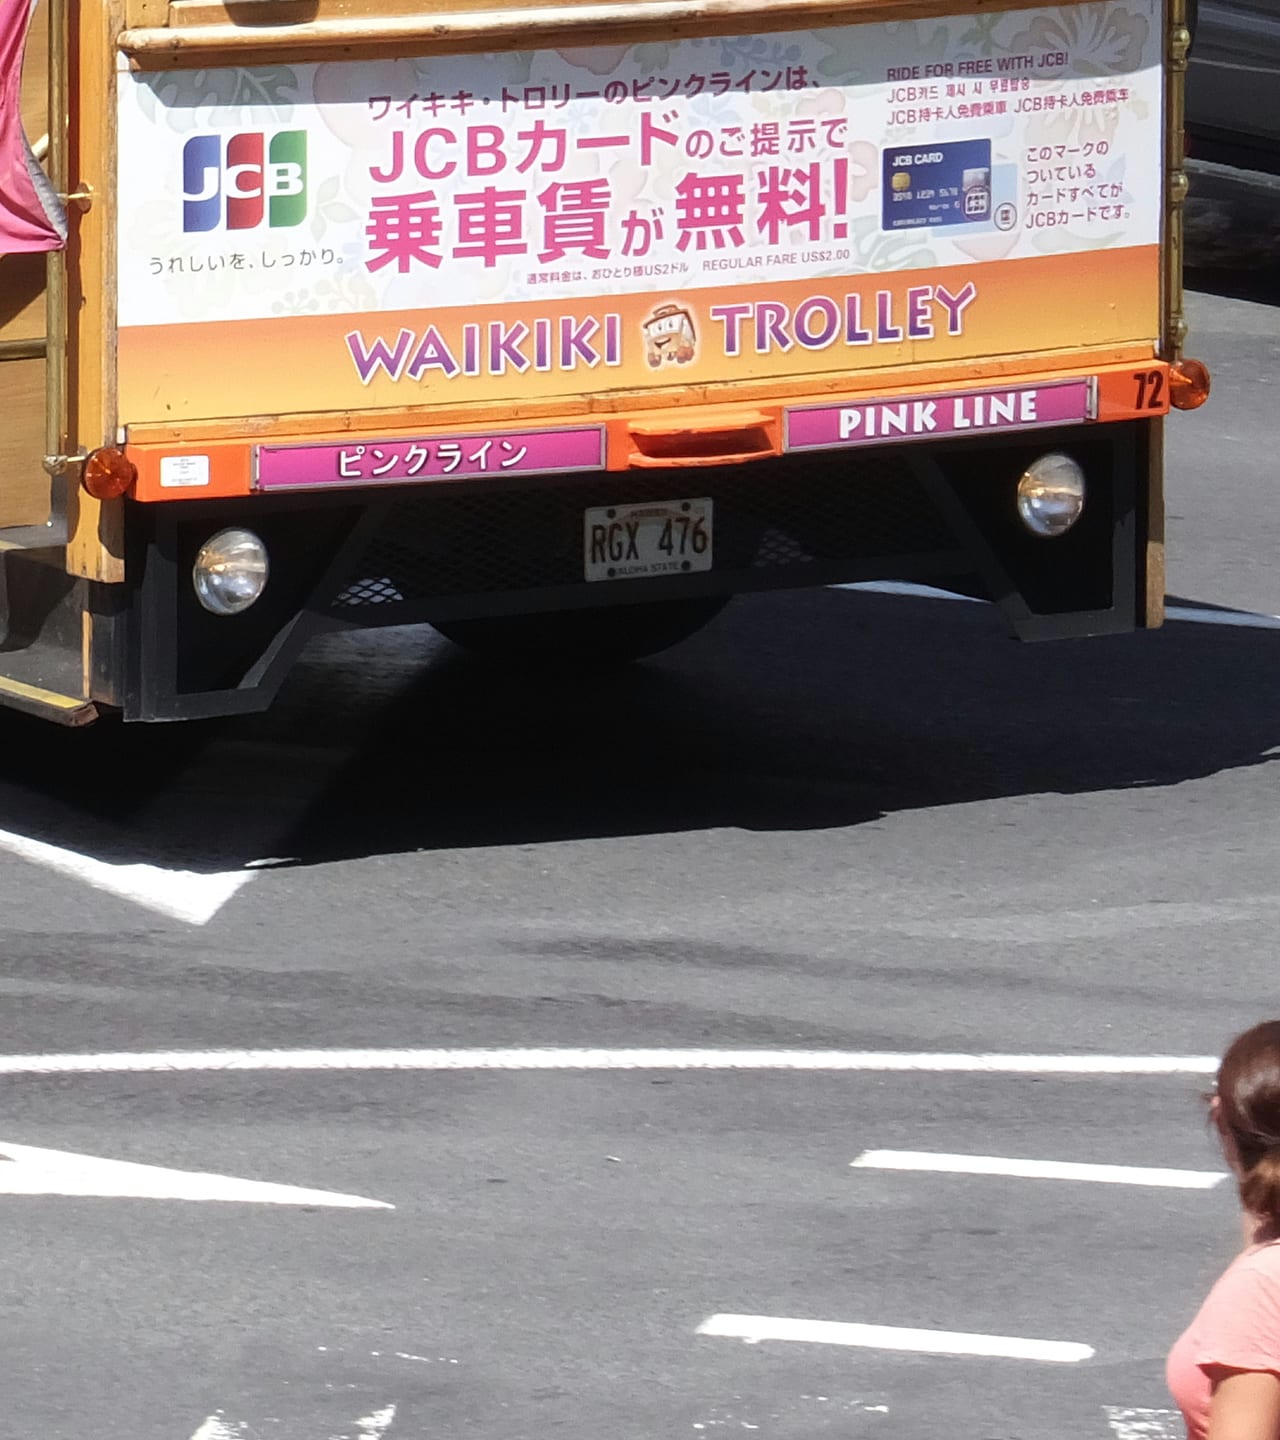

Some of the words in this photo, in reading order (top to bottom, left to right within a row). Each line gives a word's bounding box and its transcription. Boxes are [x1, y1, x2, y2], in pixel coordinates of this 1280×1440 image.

[886, 66, 920, 82] RIDE
[924, 62, 955, 79] FOR
[957, 59, 993, 76] FREE
[996, 55, 1034, 72] WITH
[1037, 52, 1069, 68] JCB!
[366, 65, 822, 121] ワイキキ・トロリーのピンクラインは、
[368, 110, 849, 183] JCBカードのご提示で
[892, 154, 912, 167] JCB
[914, 152, 944, 165] CARD
[1026, 140, 1109, 163] このマークの
[1026, 163, 1096, 183] ついている
[1026, 181, 1123, 207] カードすべてが
[364, 157, 849, 274] 乗車賃が無料!
[1025, 204, 1130, 229] JCBカードです。
[148, 247, 344, 276] うれしいを、しっかり。
[702, 256, 763, 272] REGULAR
[766, 253, 797, 266] FARE
[801, 249, 851, 263] US$2.00
[344, 312, 621, 386] WAIKIKI
[709, 282, 977, 358] TROLLEY
[1132, 369, 1164, 411] 72
[839, 400, 938, 440] PINK
[952, 390, 1039, 429] LINE
[339, 440, 528, 477] ピンクライン
[591, 521, 640, 564] RGX
[658, 515, 709, 557] 476
